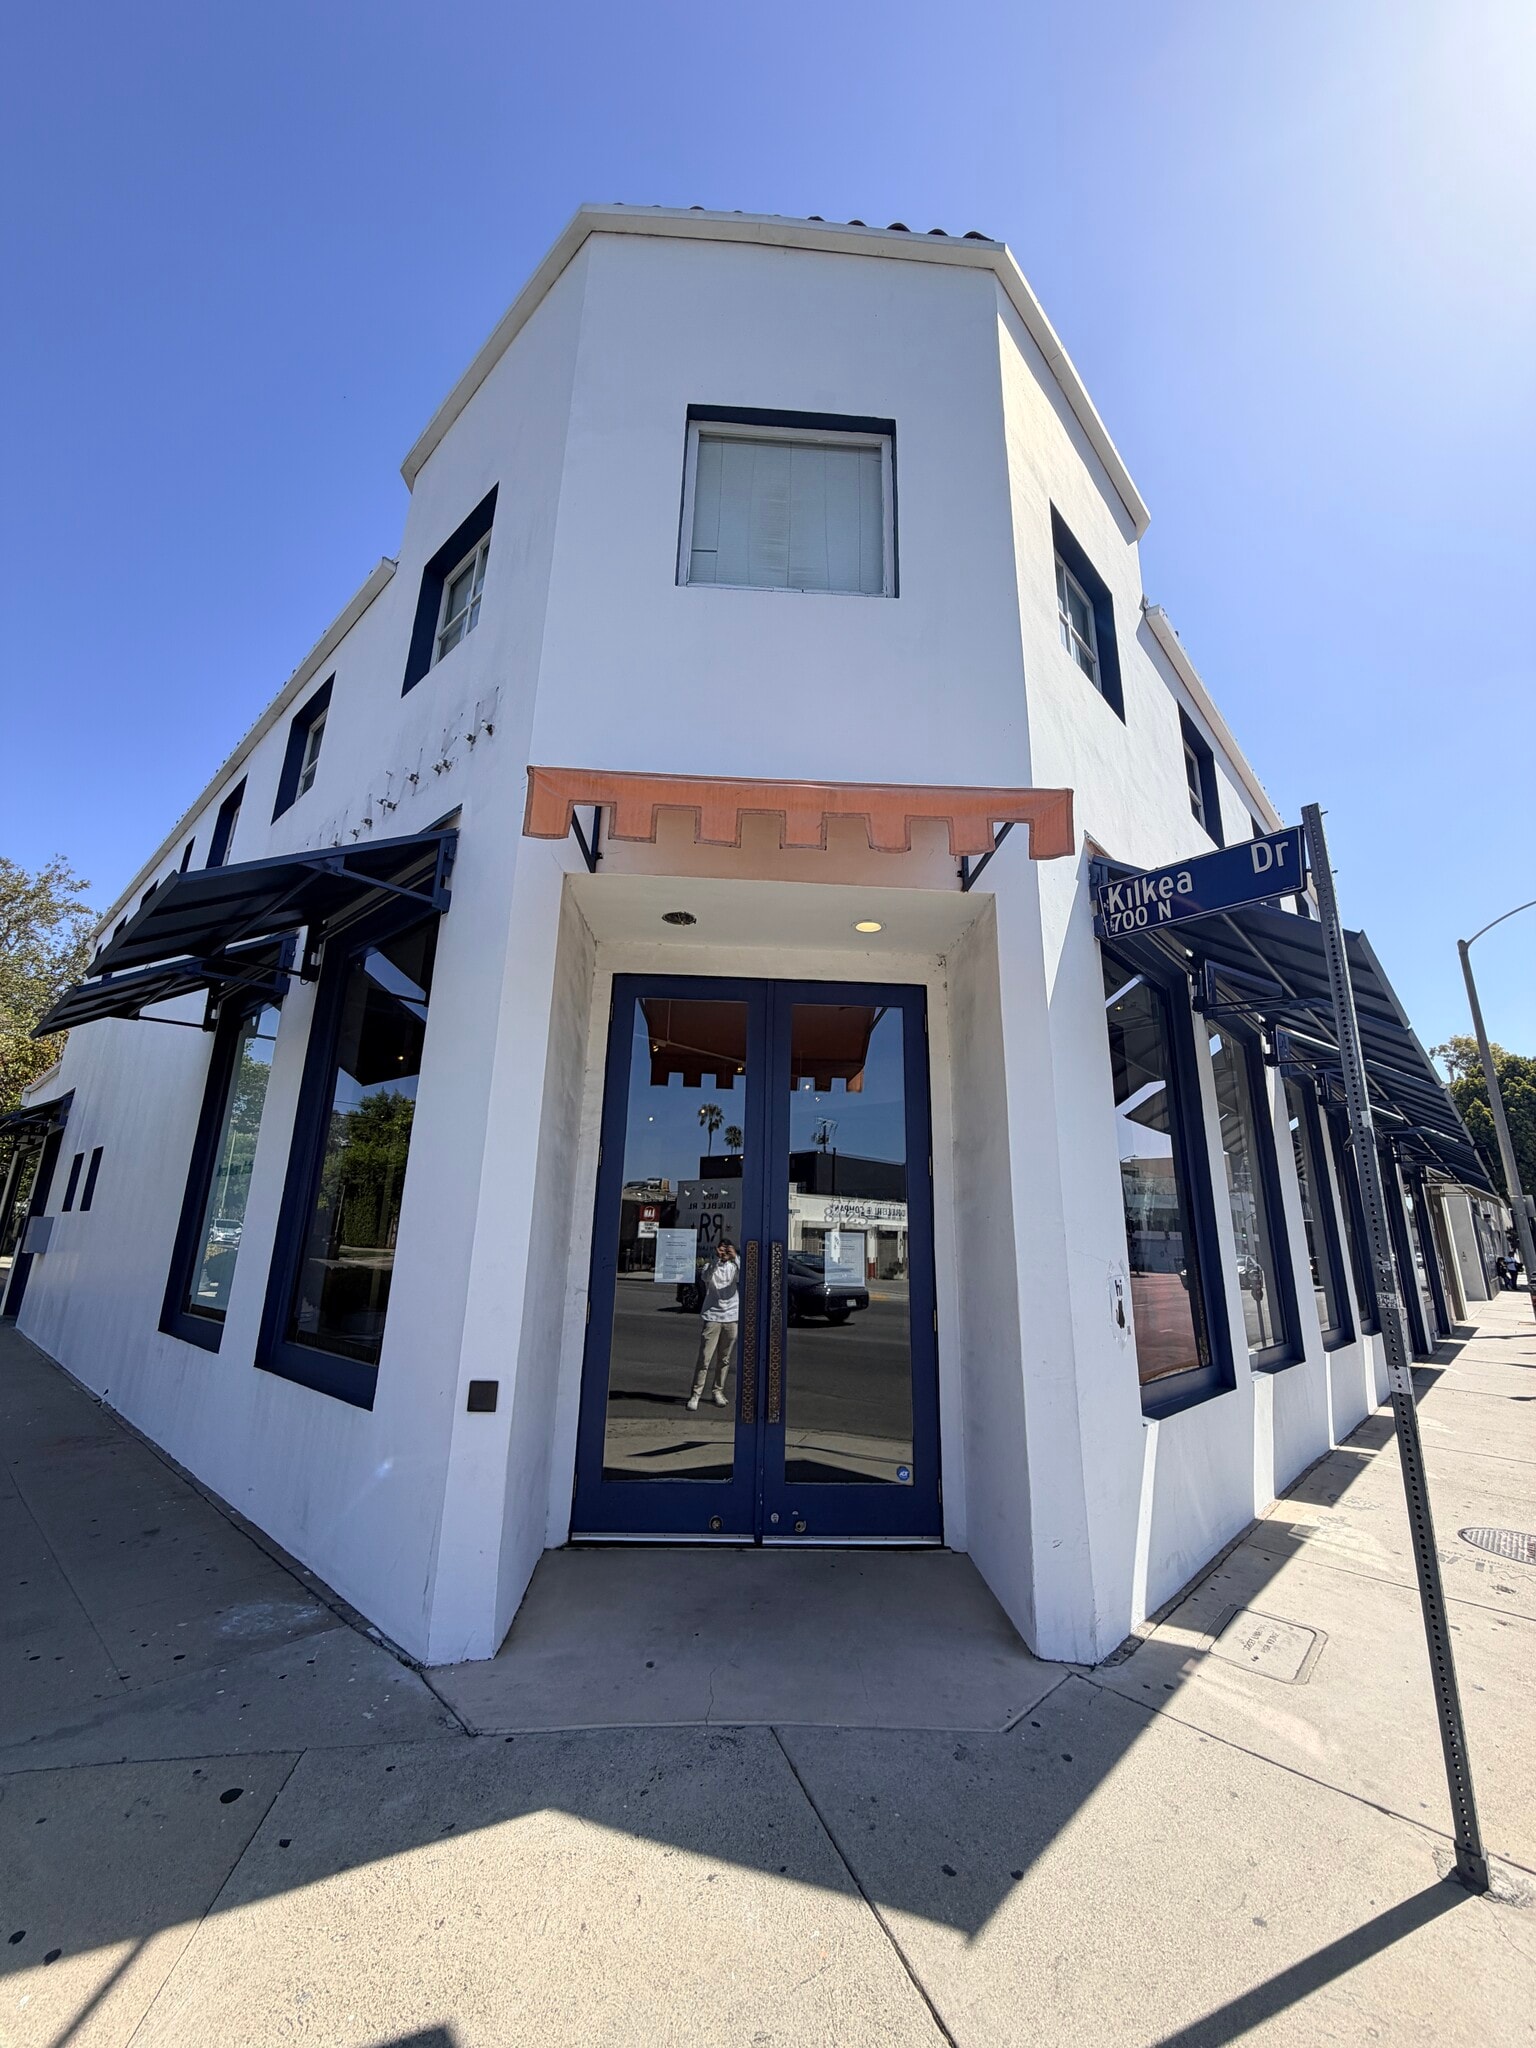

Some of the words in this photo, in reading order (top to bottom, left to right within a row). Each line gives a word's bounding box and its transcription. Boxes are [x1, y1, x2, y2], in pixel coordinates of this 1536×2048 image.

[1107, 871, 1193, 914] Kilkea
[1251, 840, 1289, 874] Dr
[1110, 906, 1148, 932] 700
[1158, 899, 1172, 921] N
